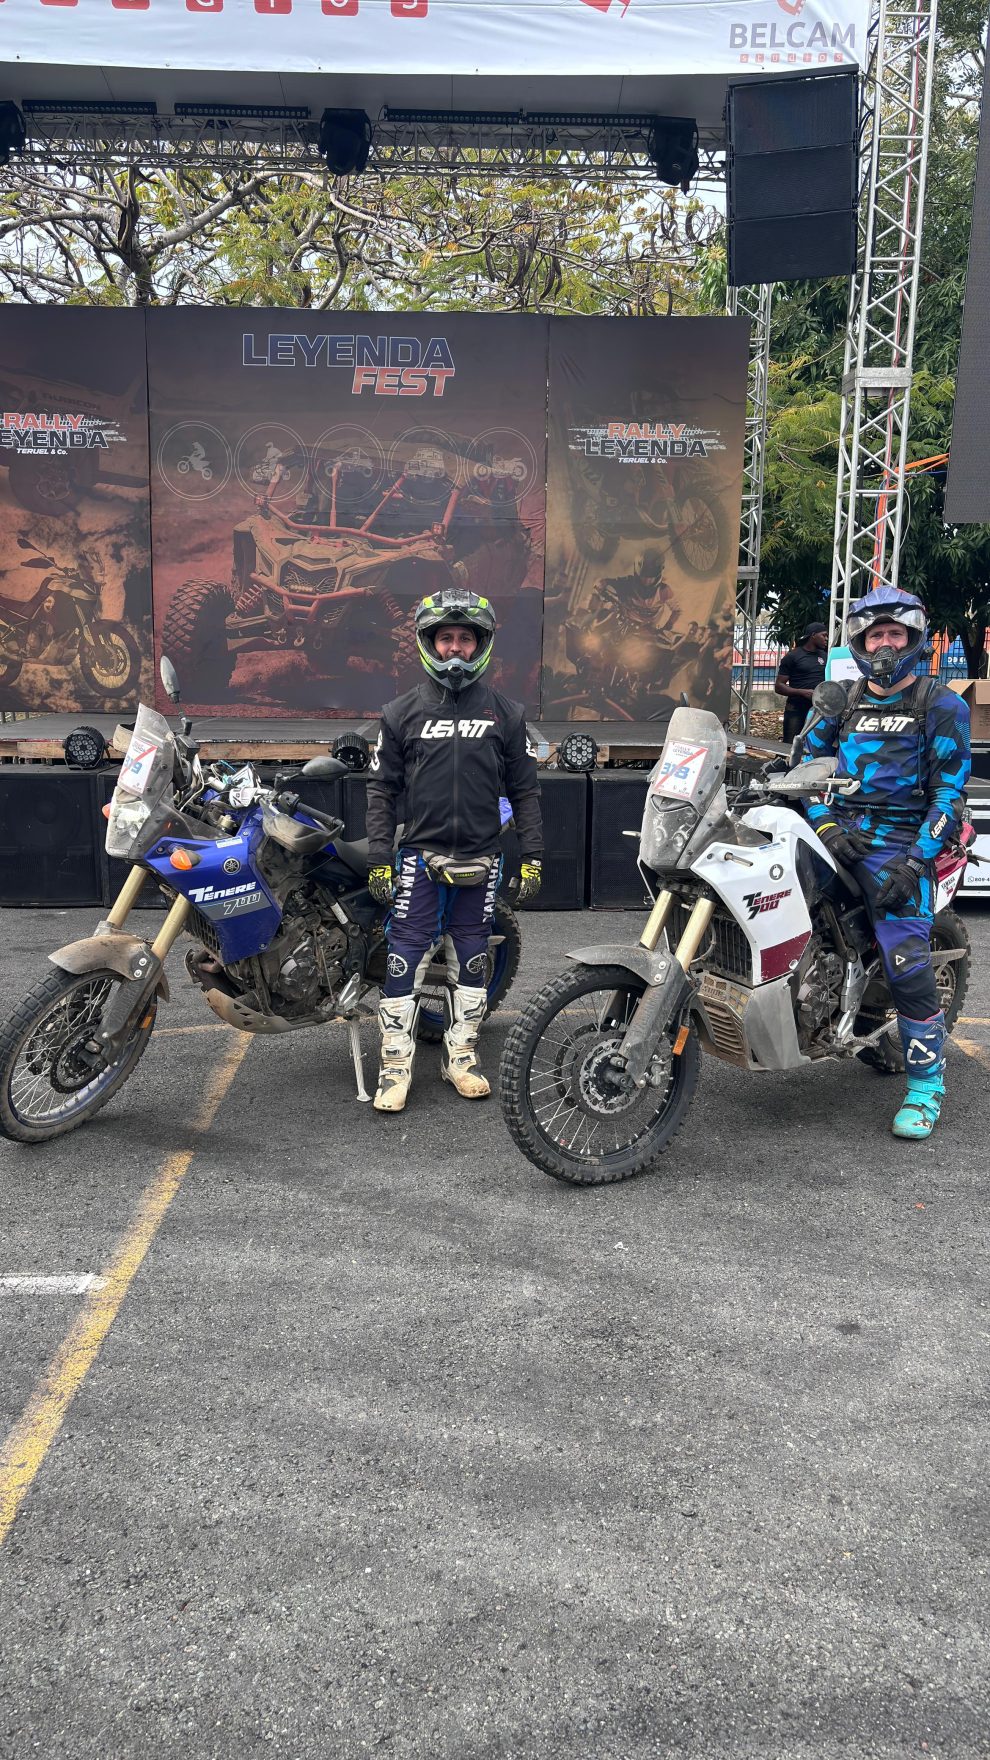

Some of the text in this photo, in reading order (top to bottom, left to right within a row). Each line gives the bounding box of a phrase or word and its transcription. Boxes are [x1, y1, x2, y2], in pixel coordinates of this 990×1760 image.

[729, 21, 856, 49] BELCAM
[242, 333, 455, 369] LEYENDA
[351, 366, 456, 397] FEST
[3, 412, 84, 431] RALLY
[608, 422, 686, 440] RALLY
[16, 447, 49, 455] TERUEL
[584, 438, 709, 458] LEYENDA
[394, 854, 417, 919] YAMAHA
[482, 857, 500, 924] YAMAHA
[223, 892, 261, 916] 700
[747, 899, 780, 922] 700
